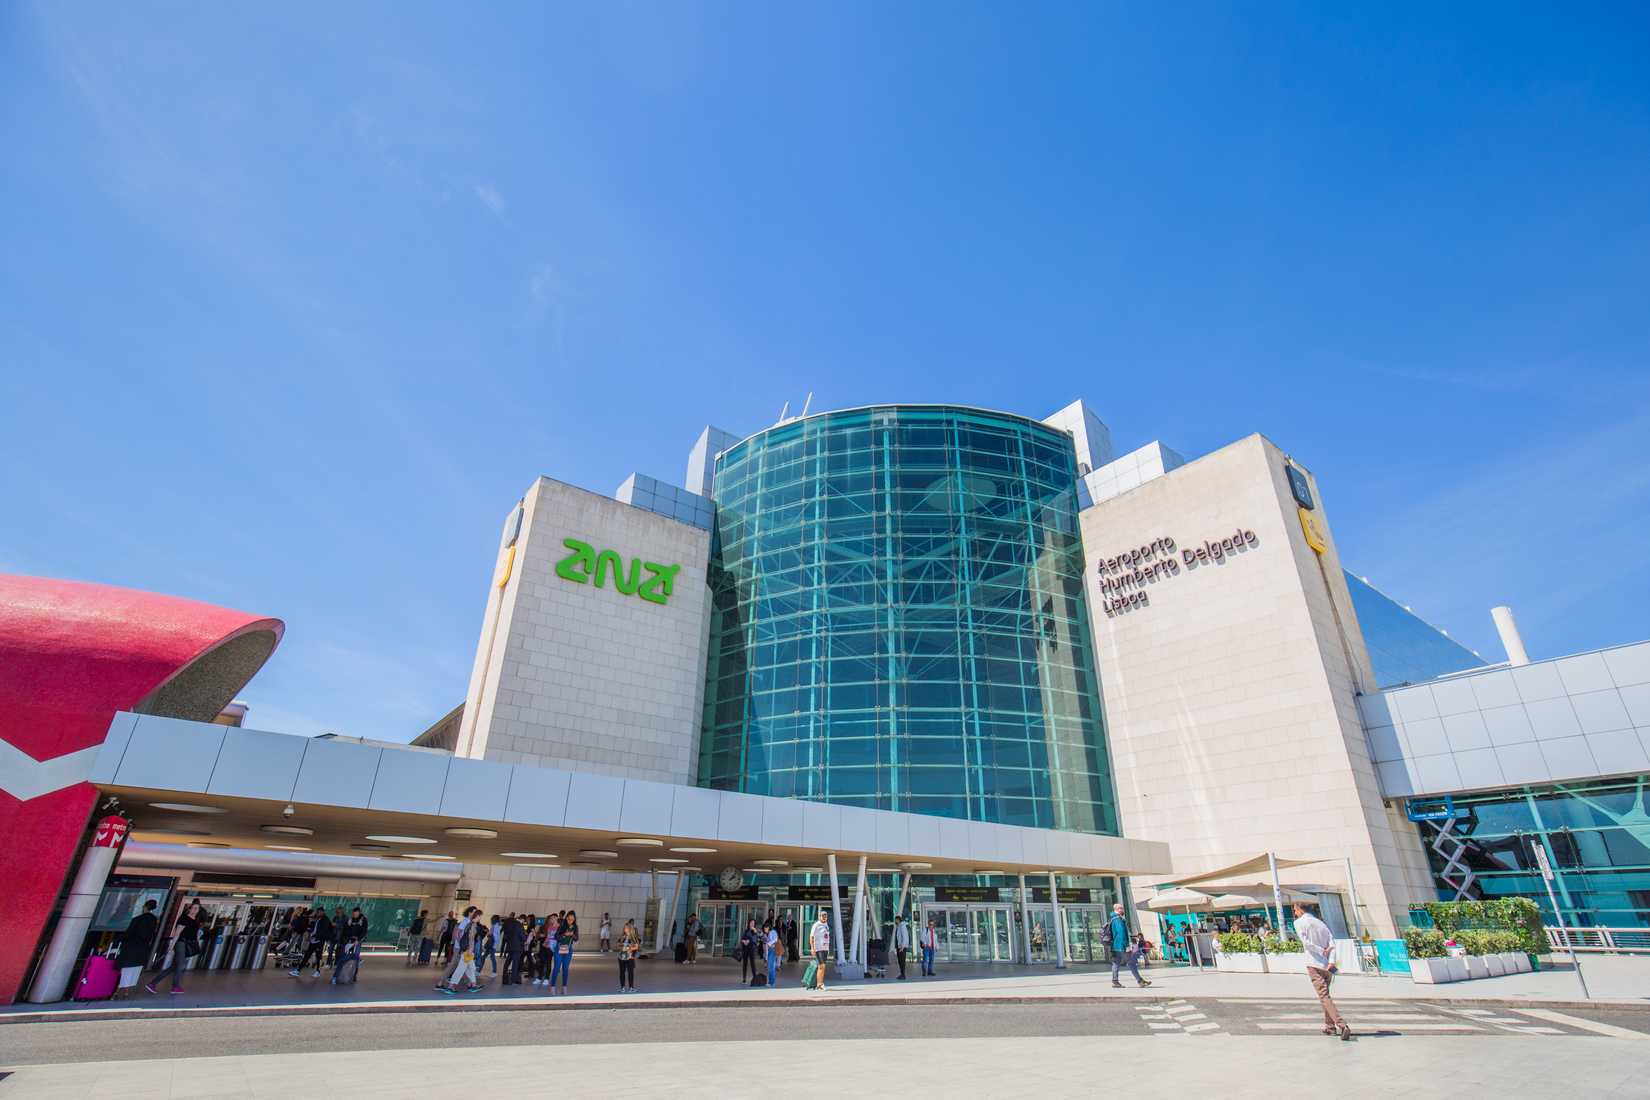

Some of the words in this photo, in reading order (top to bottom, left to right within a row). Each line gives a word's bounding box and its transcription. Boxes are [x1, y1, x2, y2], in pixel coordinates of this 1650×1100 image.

[1098, 536, 1175, 574] Aeroporto
[1099, 557, 1178, 595] Humberto
[1182, 528, 1257, 566] Delgado
[1102, 590, 1148, 614] Lisboa
